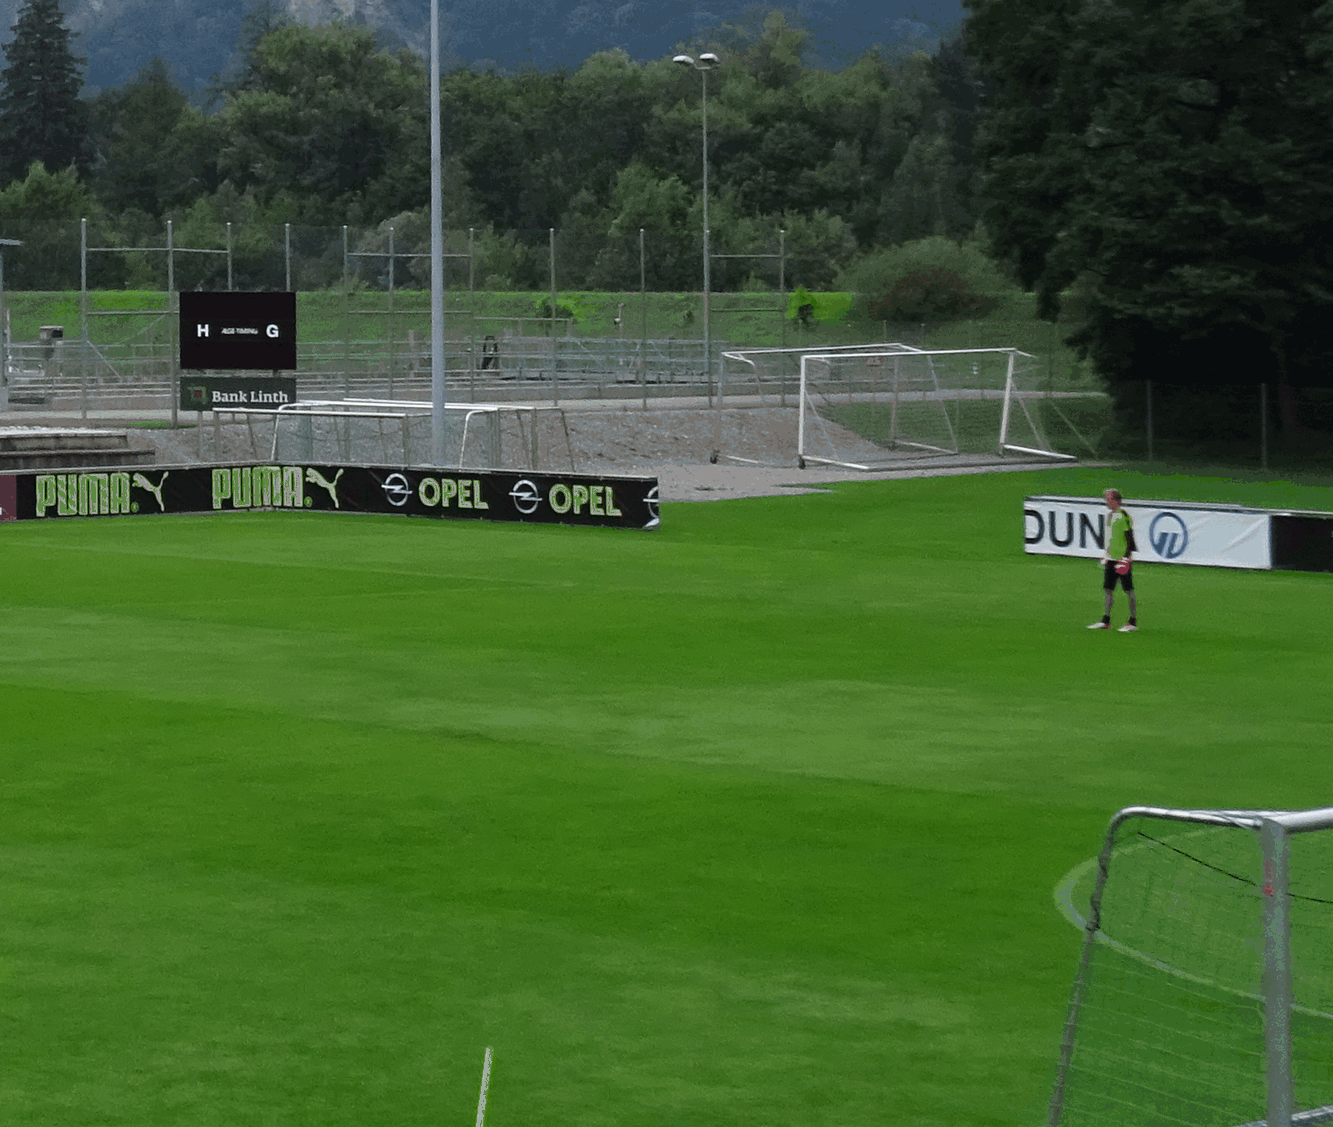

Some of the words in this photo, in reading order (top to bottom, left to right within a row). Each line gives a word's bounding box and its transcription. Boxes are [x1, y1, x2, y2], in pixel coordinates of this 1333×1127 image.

[196, 323, 210, 338] H
[265, 323, 280, 338] G
[211, 391, 248, 403] Bank
[250, 390, 289, 403] Linth
[418, 477, 490, 510] OPEL
[548, 483, 623, 517] OPEL
[1025, 509, 1138, 552] DUN
